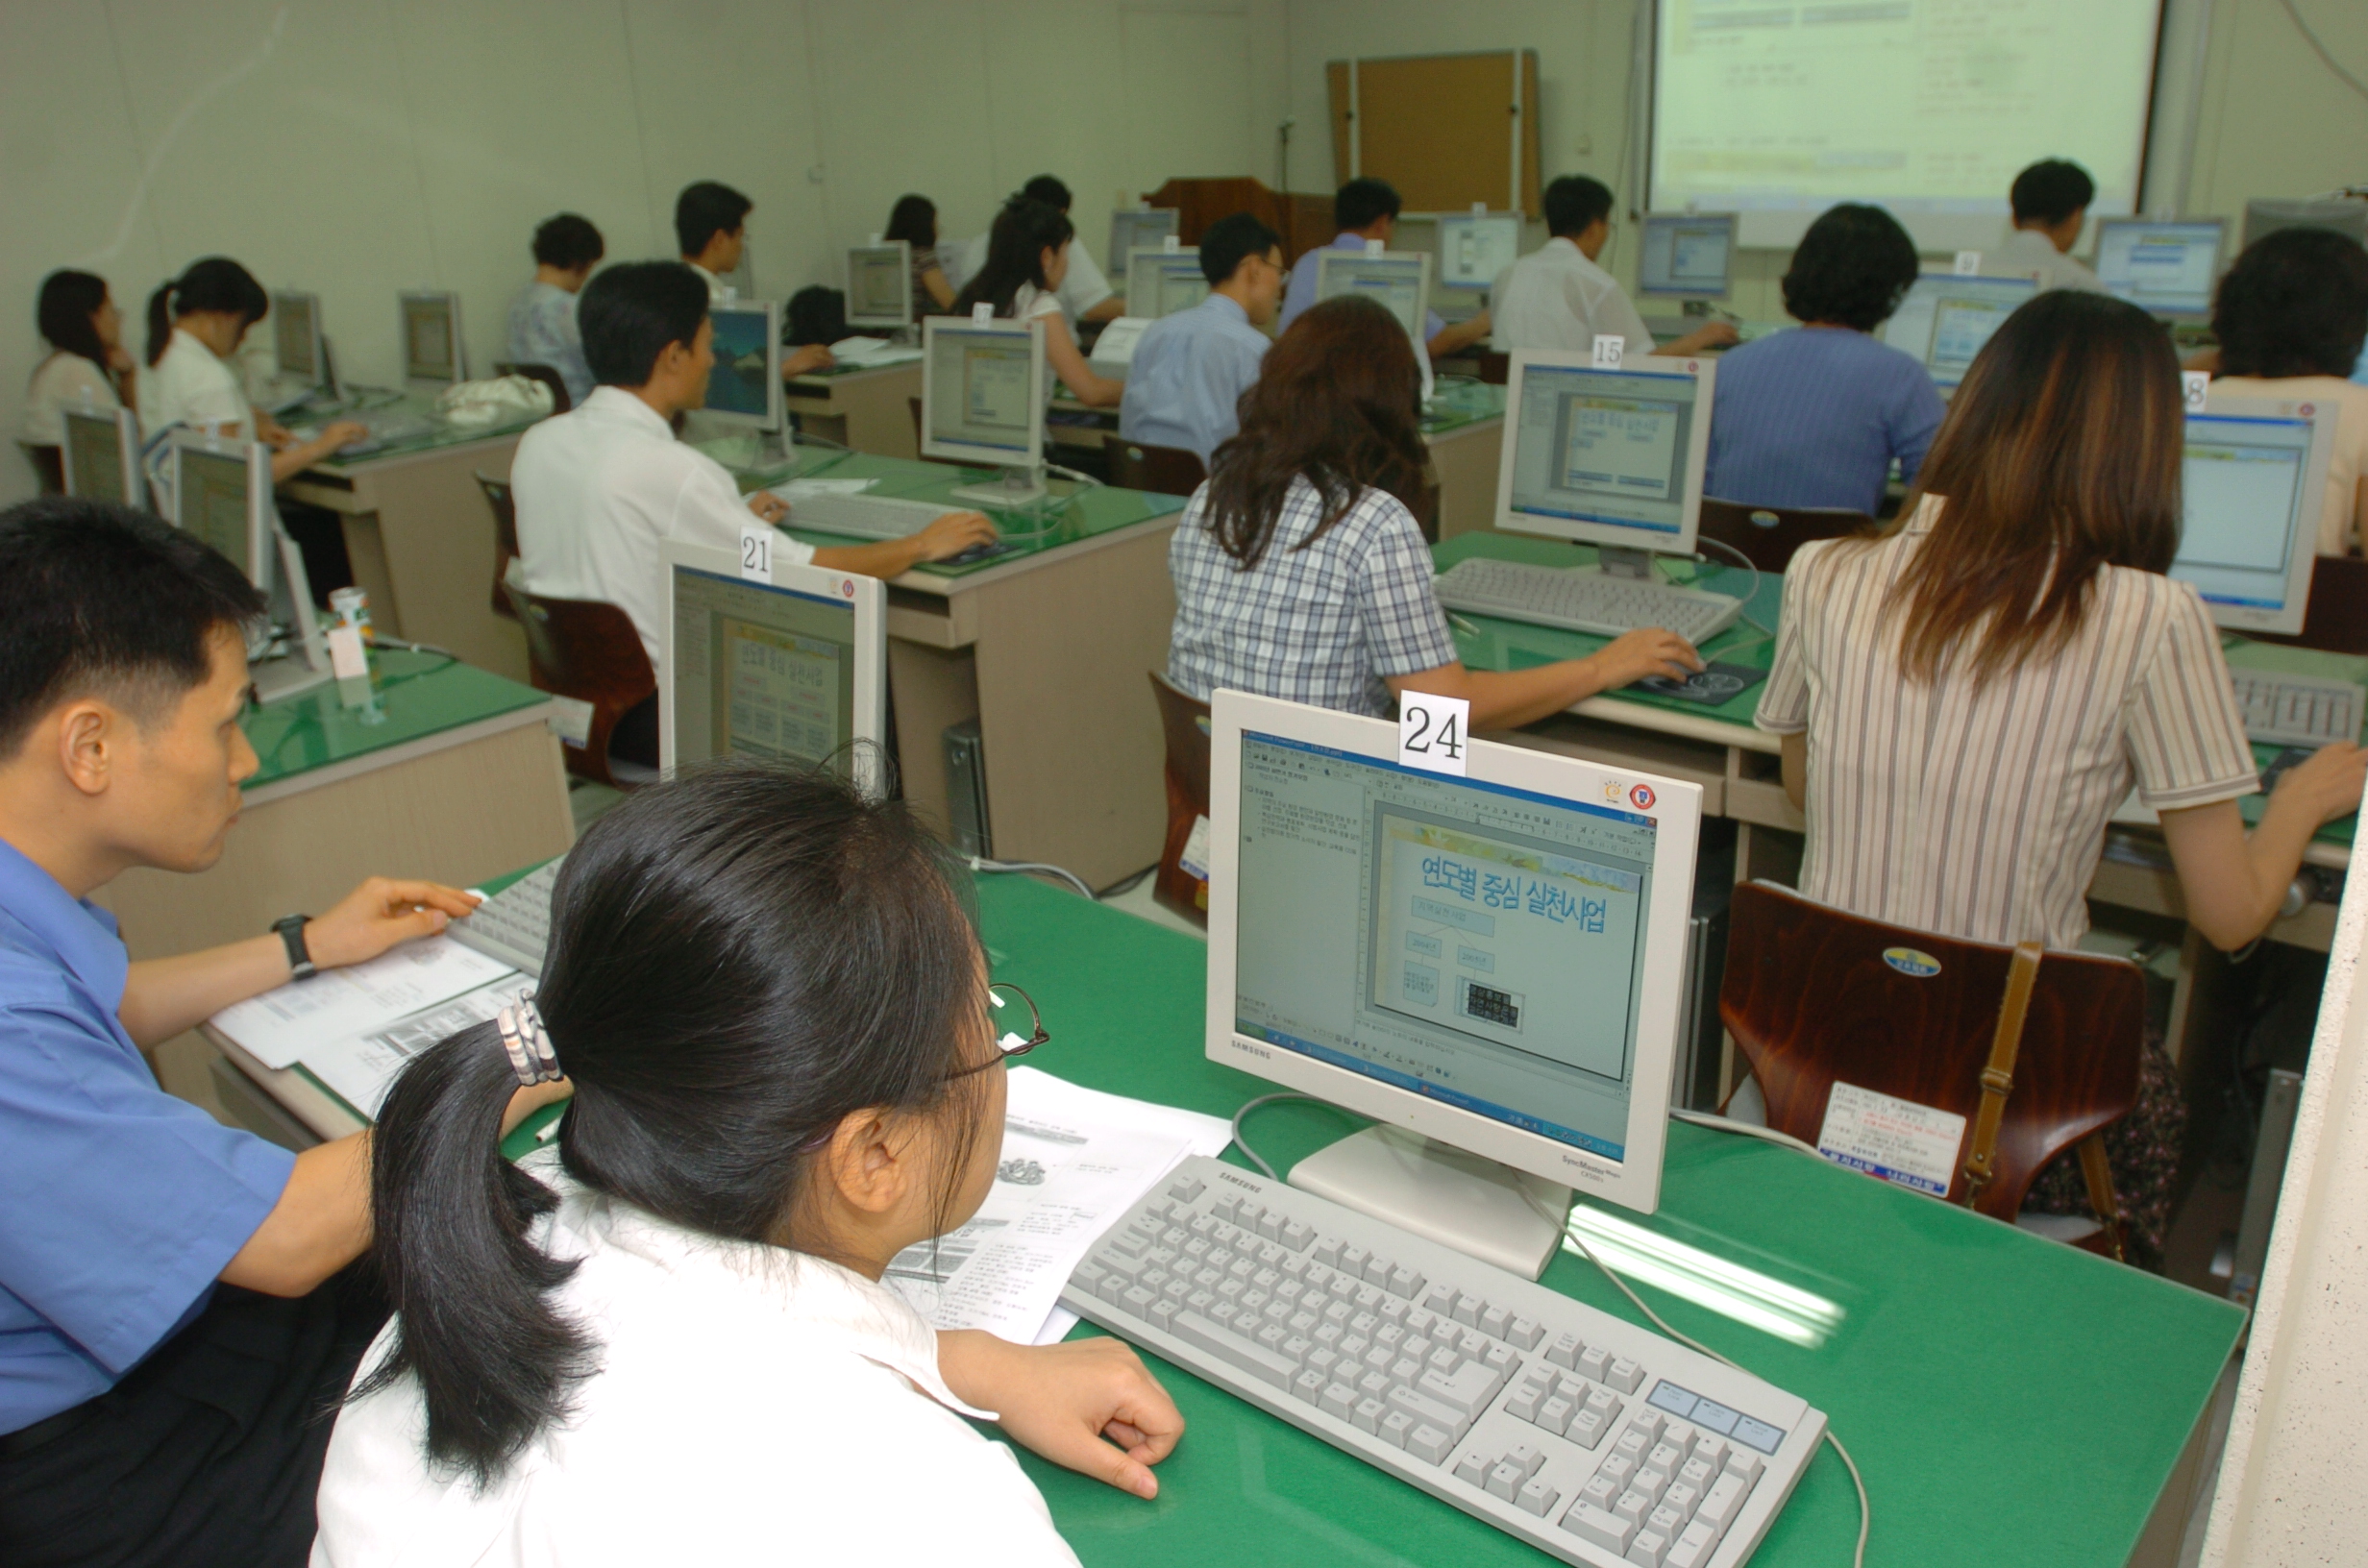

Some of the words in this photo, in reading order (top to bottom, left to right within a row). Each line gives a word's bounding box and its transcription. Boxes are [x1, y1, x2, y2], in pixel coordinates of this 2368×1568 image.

[1595, 340, 1621, 363] 15
[742, 536, 769, 573] 21
[1404, 706, 1463, 760] 24
[1421, 855, 1477, 902] 연도별
[1482, 872, 1521, 910] 중심
[1526, 880, 1607, 934] 실천사업
[1231, 1040, 1271, 1061] SAMSUNG
[1562, 1155, 1604, 1176] SyncMaster
[1219, 1171, 1263, 1194] SAMSUNG
[1682, 1537, 1698, 1548] Enter
